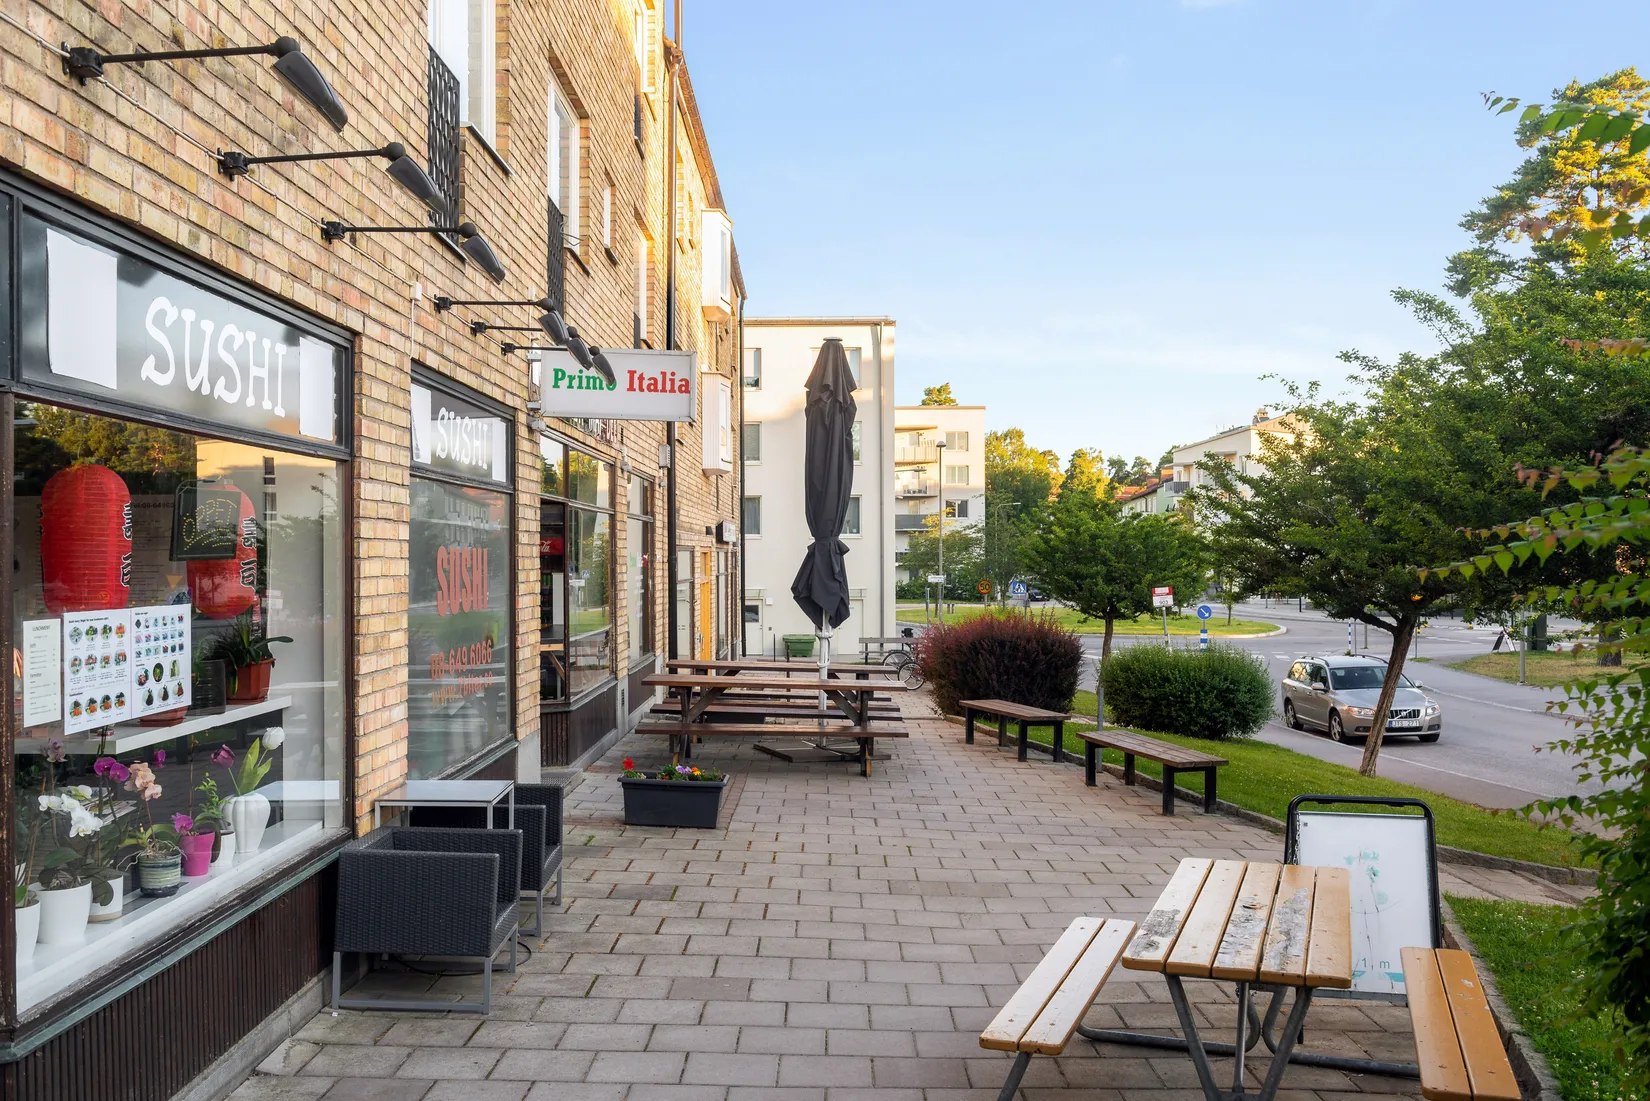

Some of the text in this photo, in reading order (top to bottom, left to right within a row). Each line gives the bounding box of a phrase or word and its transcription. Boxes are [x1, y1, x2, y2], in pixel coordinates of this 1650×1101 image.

[141, 296, 286, 418] SUSHI
[626, 369, 690, 395] Italia
[436, 406, 488, 470] SUSHI
[436, 546, 488, 617] SUSHI
[980, 583, 990, 591] 50
